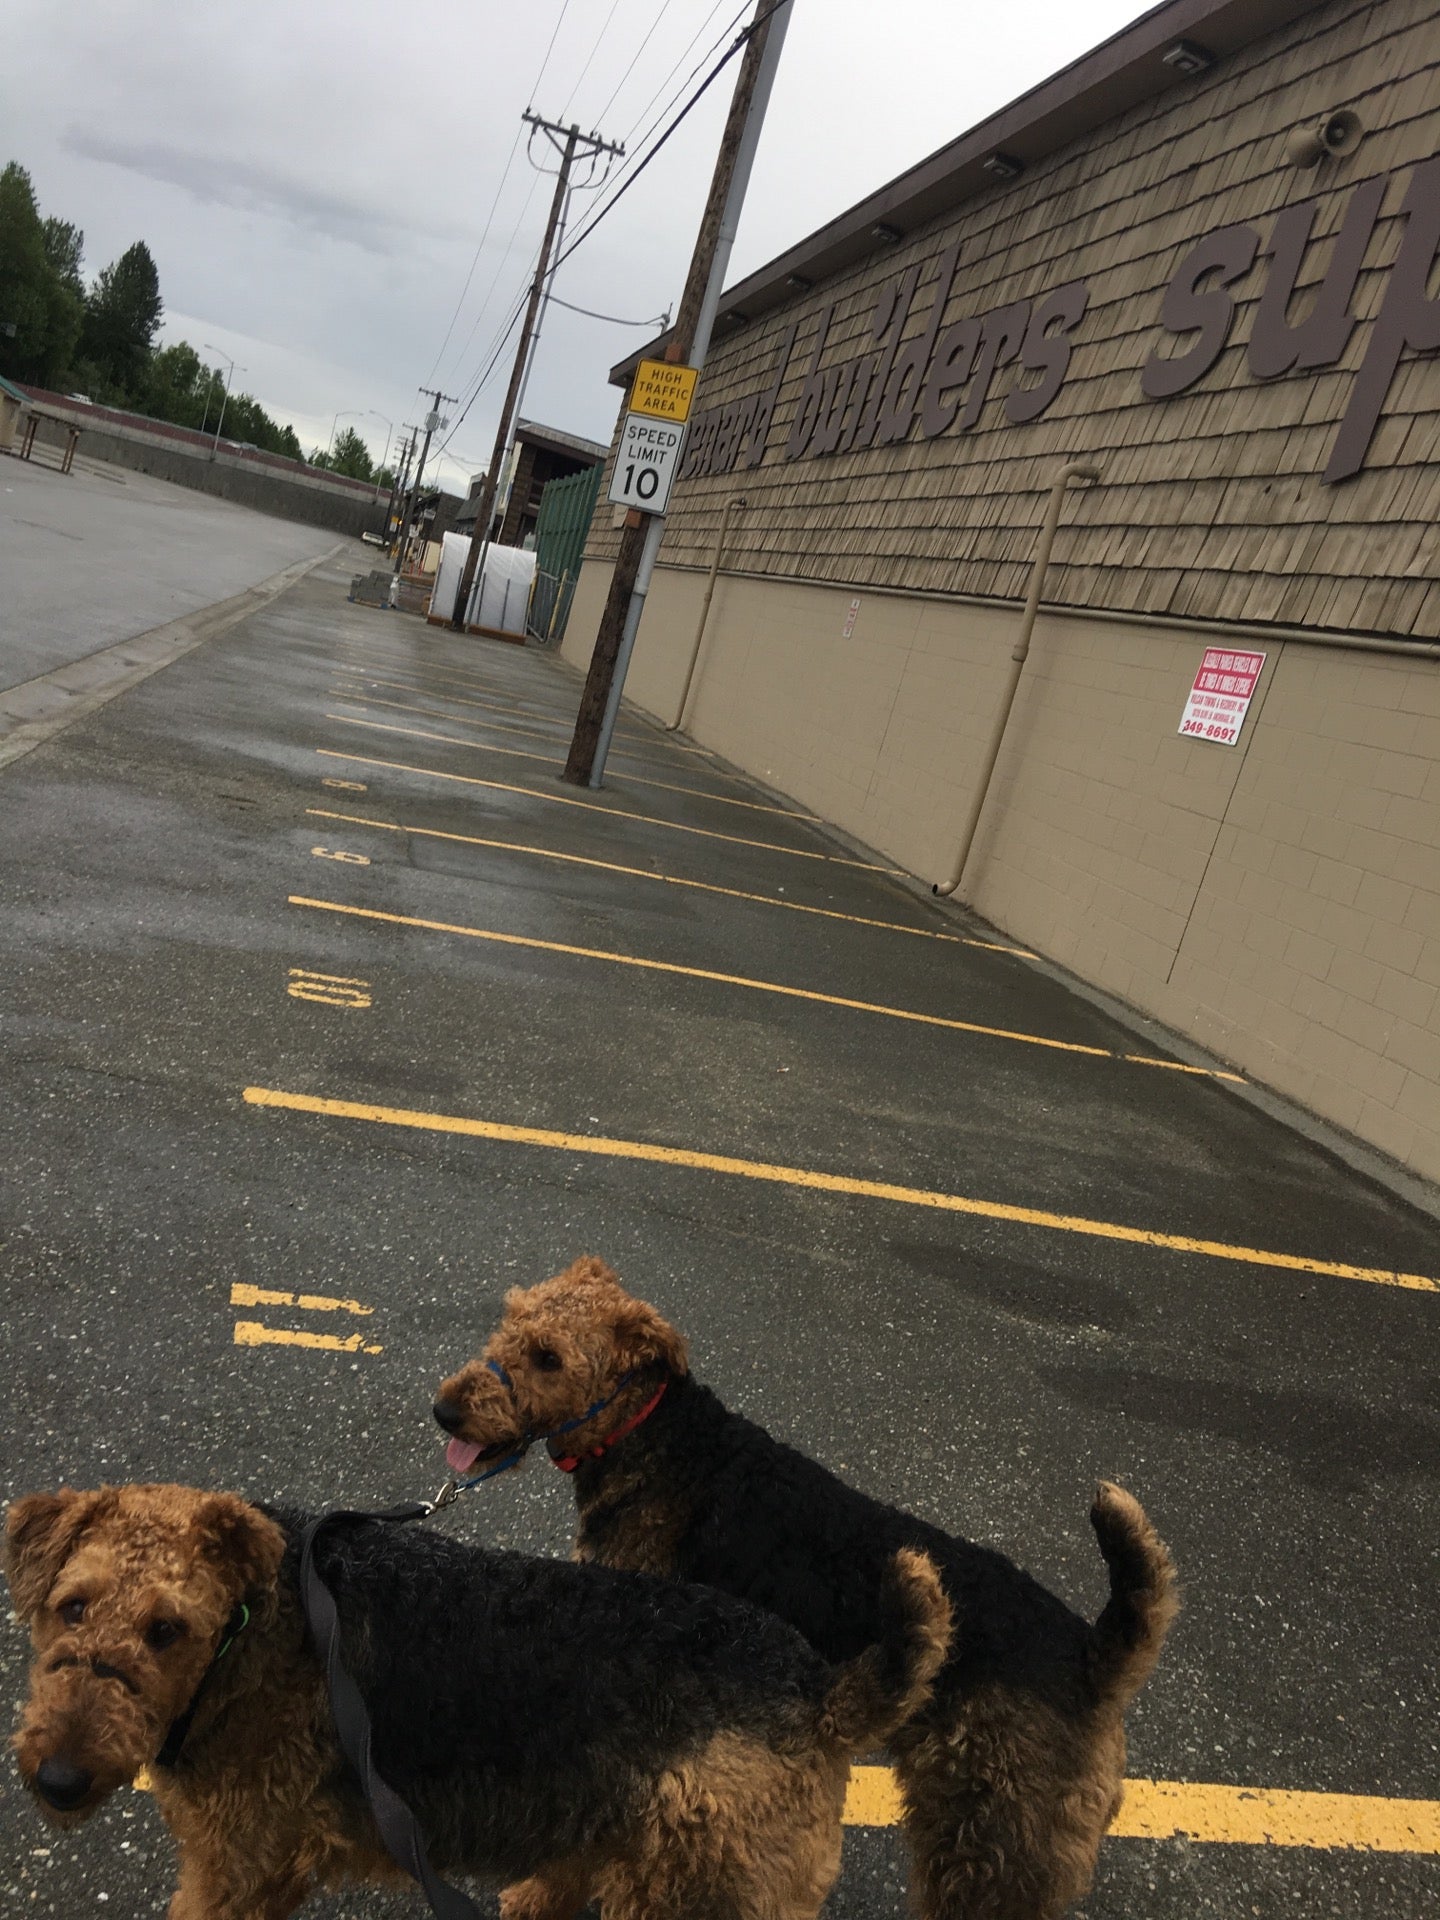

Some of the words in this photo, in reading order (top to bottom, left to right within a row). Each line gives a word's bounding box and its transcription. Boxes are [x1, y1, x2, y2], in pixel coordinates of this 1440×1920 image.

[785, 240, 1089, 461] builders
[651, 369, 682, 384] HIGH
[640, 381, 689, 401] TRAFFIC
[643, 399, 676, 412] AREA
[627, 425, 677, 448] SPEED
[627, 444, 668, 465] LIMIT
[623, 464, 659, 499] 10
[1182, 719, 1236, 740] 349-8697
